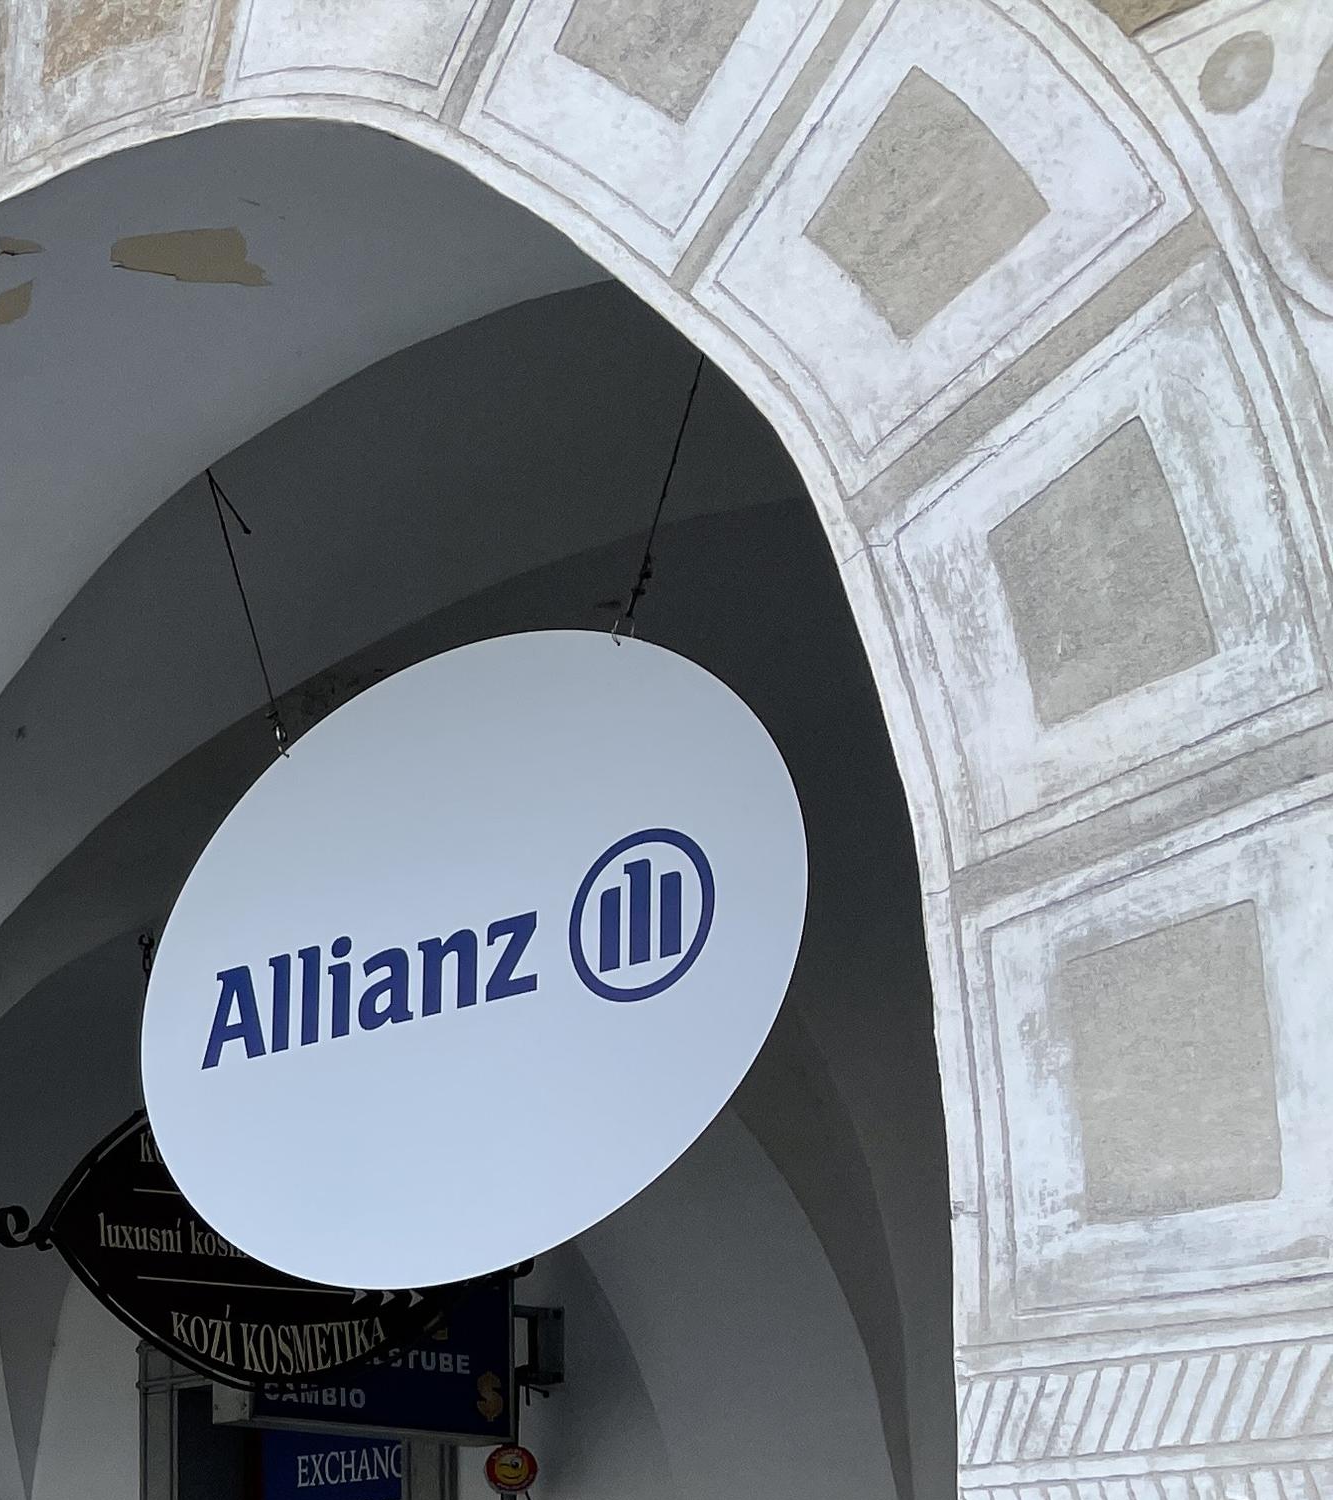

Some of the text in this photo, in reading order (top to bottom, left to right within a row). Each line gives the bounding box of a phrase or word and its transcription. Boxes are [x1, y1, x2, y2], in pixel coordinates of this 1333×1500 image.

[201, 910, 538, 1070] Allianz
[98, 1212, 182, 1253] luxusní
[171, 1304, 388, 1376] KOZÍ KOSMETIKA
